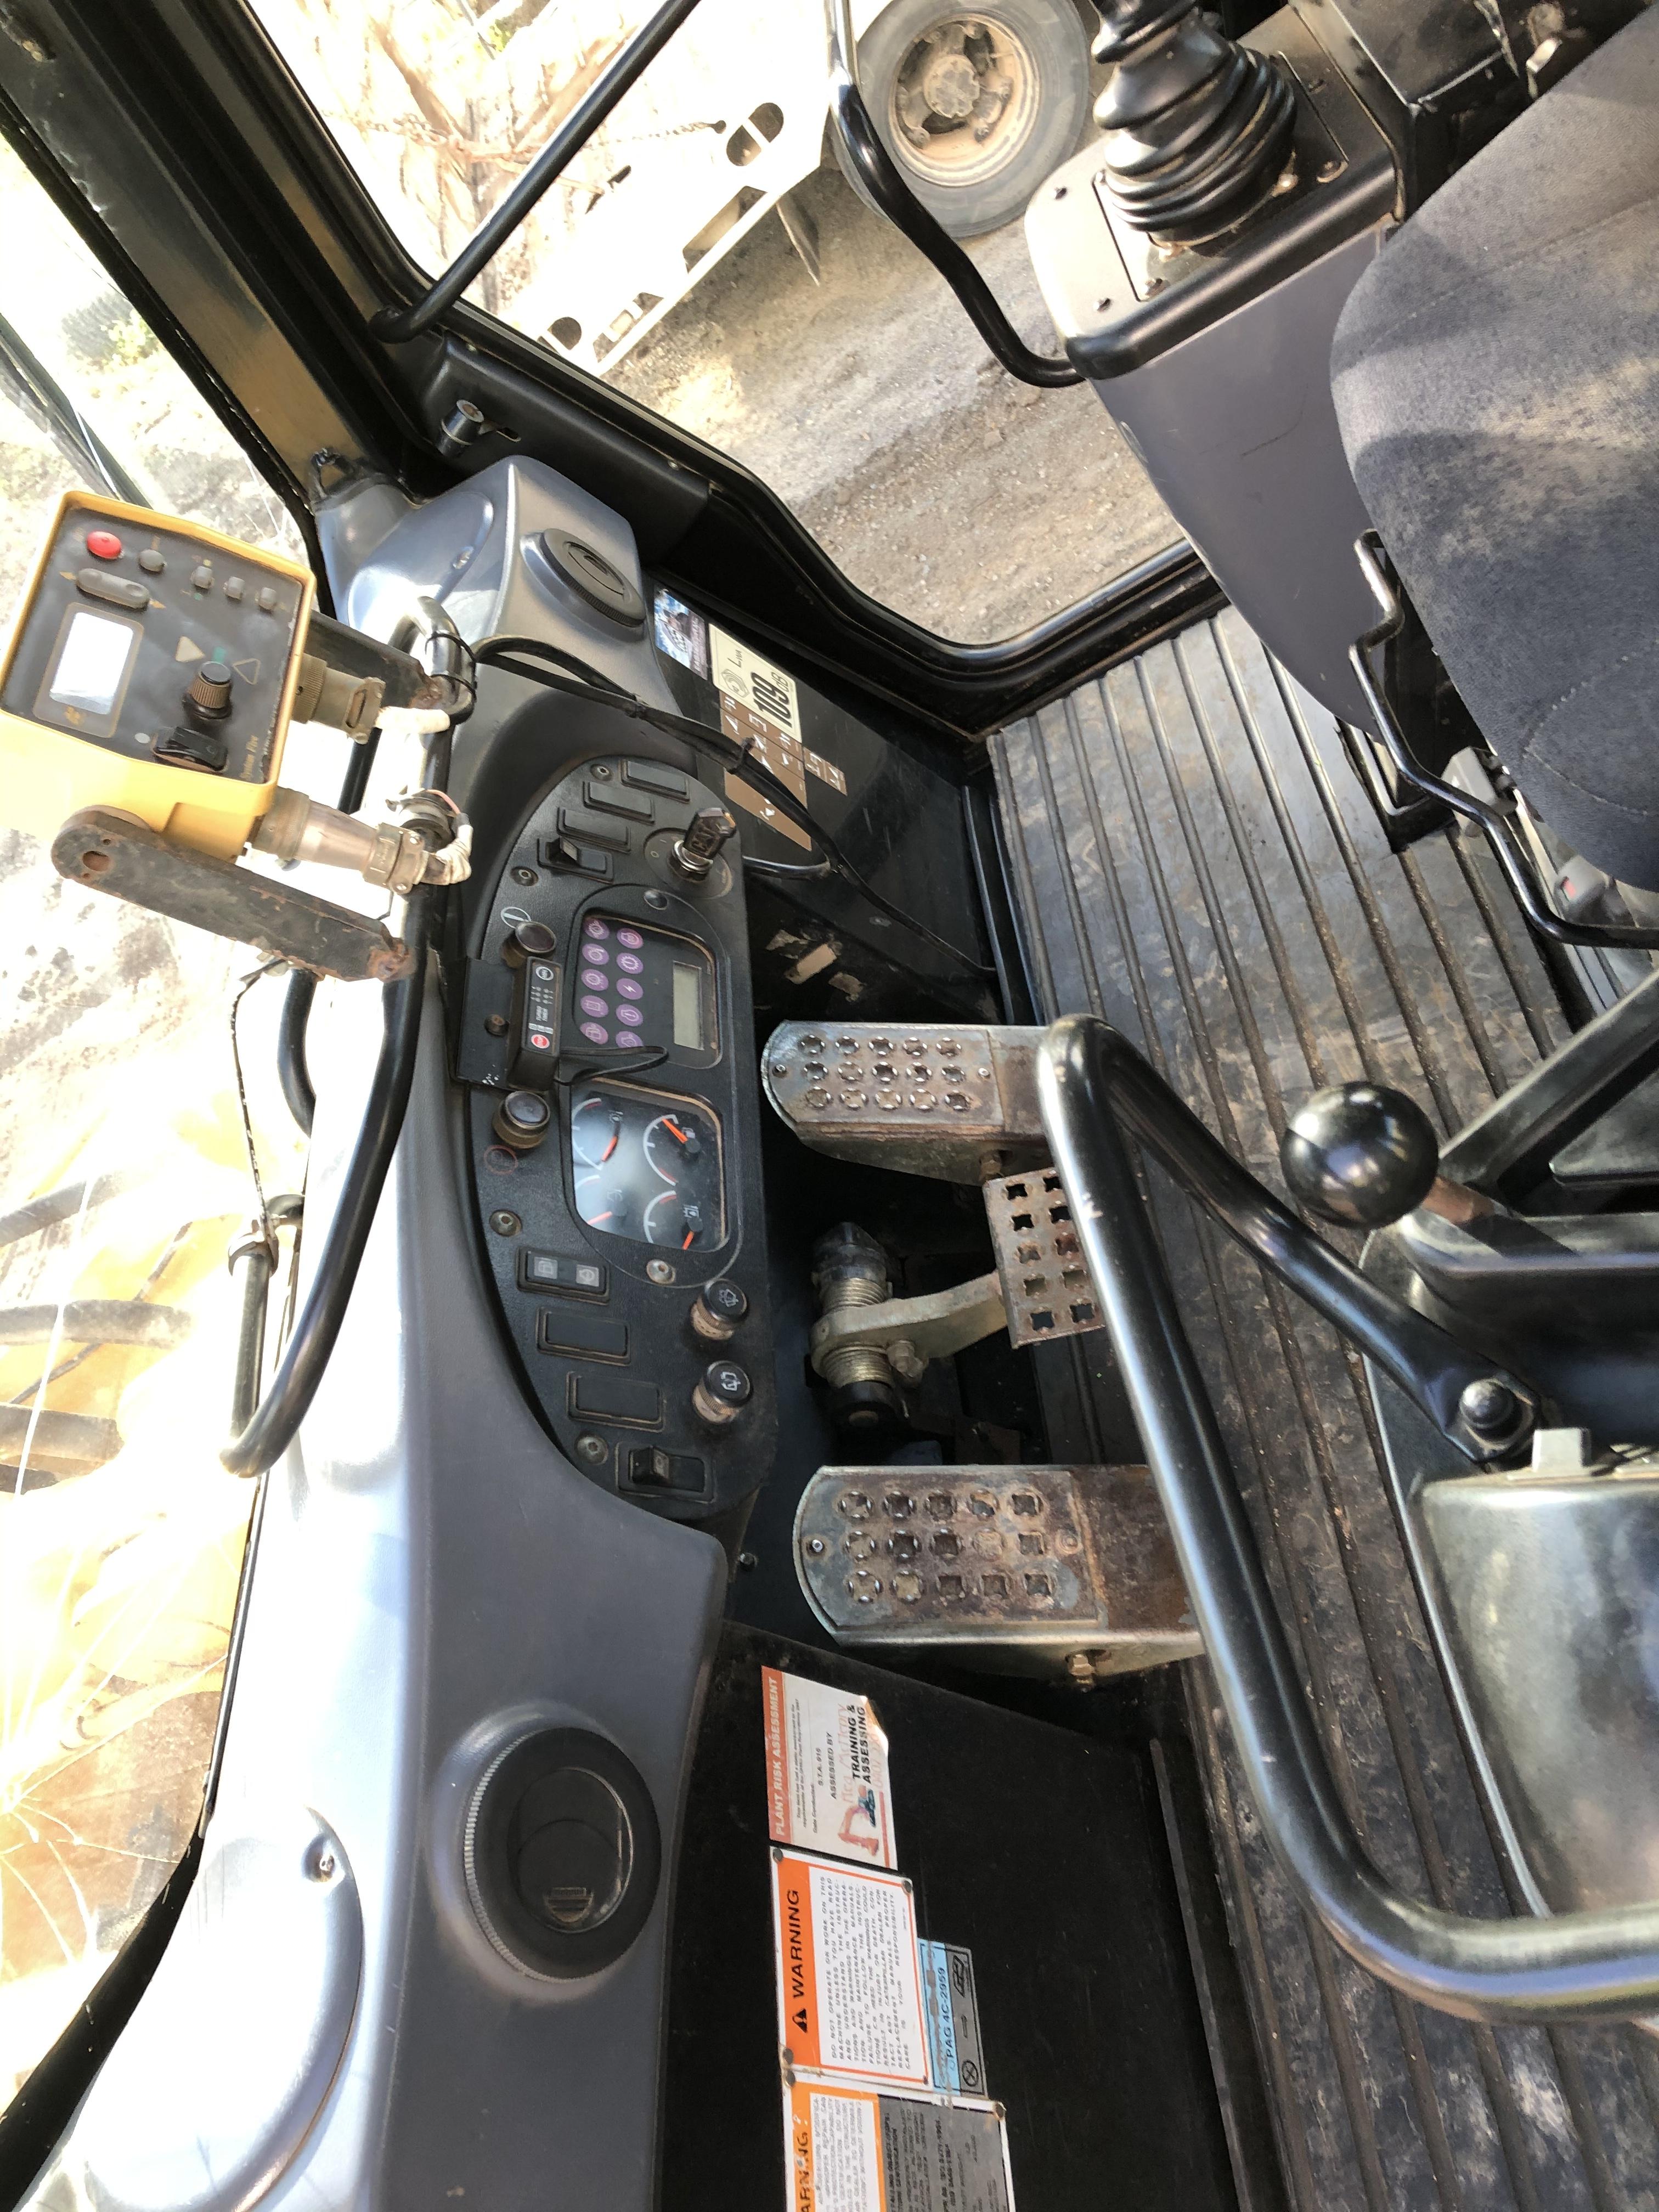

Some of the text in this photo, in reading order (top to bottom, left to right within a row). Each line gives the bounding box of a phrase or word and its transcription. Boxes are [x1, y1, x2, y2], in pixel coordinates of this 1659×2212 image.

[750, 671, 793, 729] 109 dB
[768, 1675, 785, 1836] PLANT RISK ASSESSMENT
[826, 1731, 836, 1799] ASSESSED BY
[848, 1717, 860, 1780] TRAINING
[856, 1706, 871, 1784] ASSESSING
[821, 1900, 827, 1914] ON
[876, 1911, 884, 1944] DEALER
[881, 1889, 890, 1927] PROPER
[787, 1889, 805, 2000] WARNING
[864, 1917, 872, 1960] WARNINGS
[826, 1969, 834, 2013] OPERATE
[832, 1966, 840, 2006] UNLESS
[846, 1954, 854, 2002] WARNINGS
[851, 1935, 862, 2002] MAINTENANCE
[860, 1955, 868, 1996] FOLLOW
[875, 1972, 883, 2006] INJURY
[880, 1949, 890, 2006] CATERPILLAR
[839, 1960, 849, 2029] UNDERSTAND
[864, 2003, 870, 2015] TO
[936, 1967, 950, 2023] 4C-2959
[831, 2044, 837, 2058] DO
[836, 2012, 844, 2059] MACHINE
[865, 2023, 874, 2064] FAILURE
[880, 2029, 889, 2066] RESULT
[891, 1995, 903, 2068] REPLACEMENT
